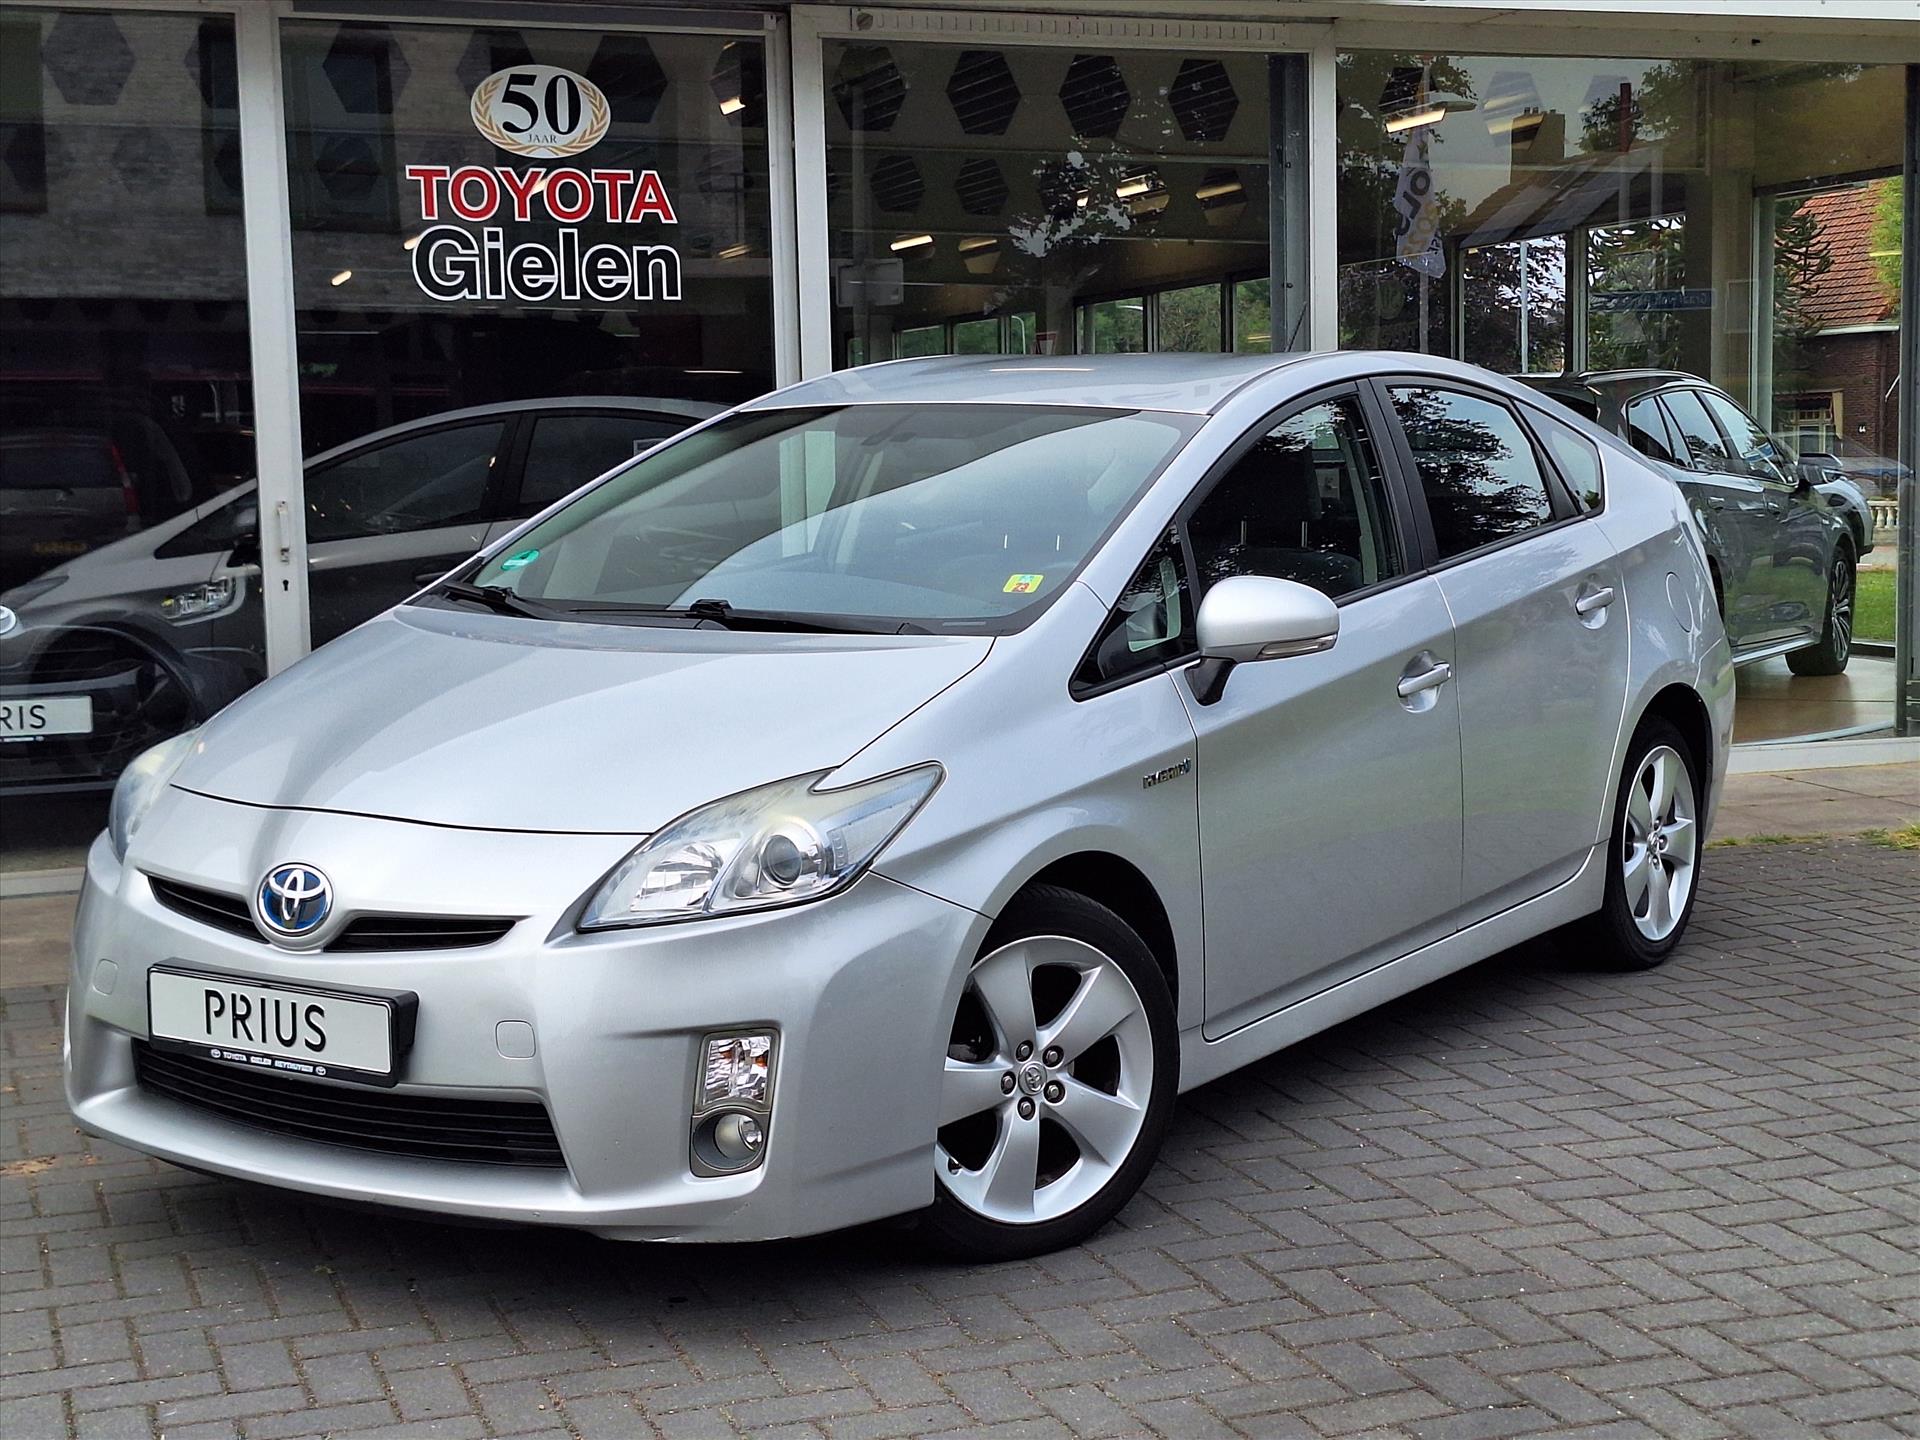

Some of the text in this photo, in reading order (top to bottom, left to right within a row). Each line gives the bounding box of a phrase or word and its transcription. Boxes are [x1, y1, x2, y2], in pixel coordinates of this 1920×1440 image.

[501, 73, 582, 135] 50
[528, 134, 558, 144] JAAR
[405, 165, 678, 224] TOYOTA
[412, 225, 682, 301] Gielen
[204, 988, 327, 1052] PRIUS
